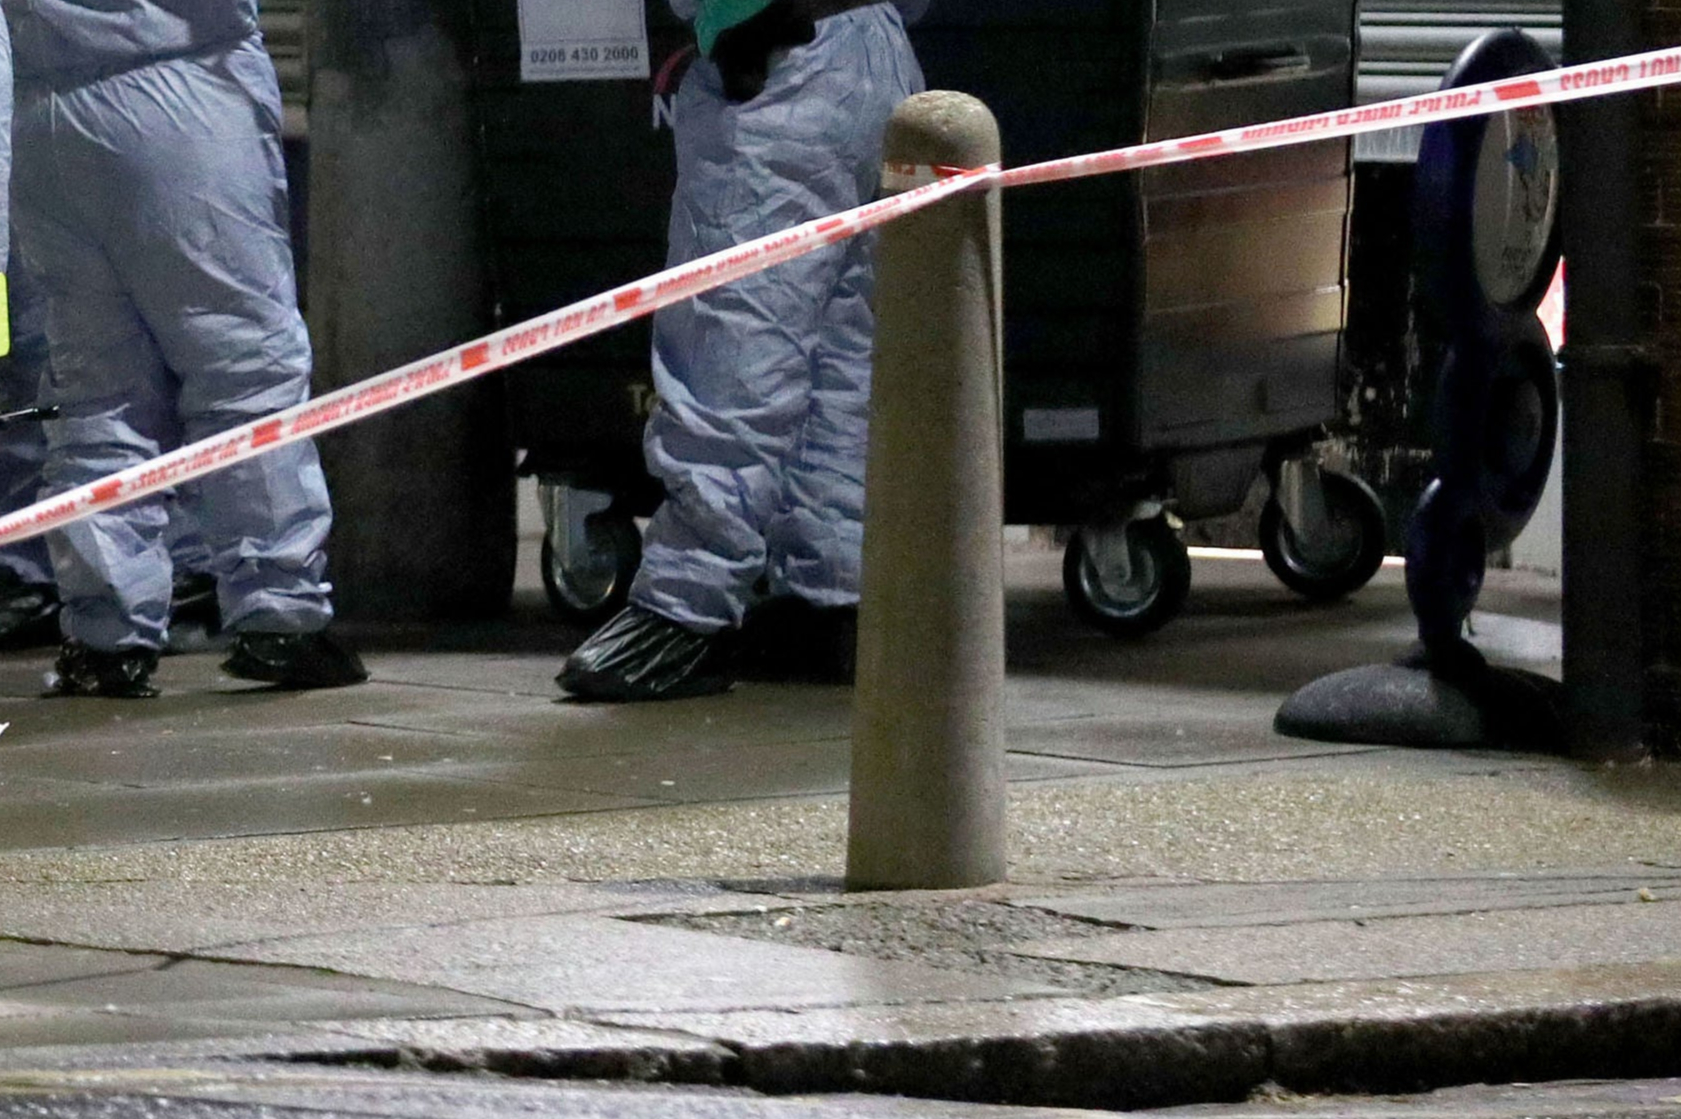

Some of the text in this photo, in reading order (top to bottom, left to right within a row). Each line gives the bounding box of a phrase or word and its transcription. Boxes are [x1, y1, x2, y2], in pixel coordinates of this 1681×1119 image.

[531, 44, 638, 63] 0208 430 2000
